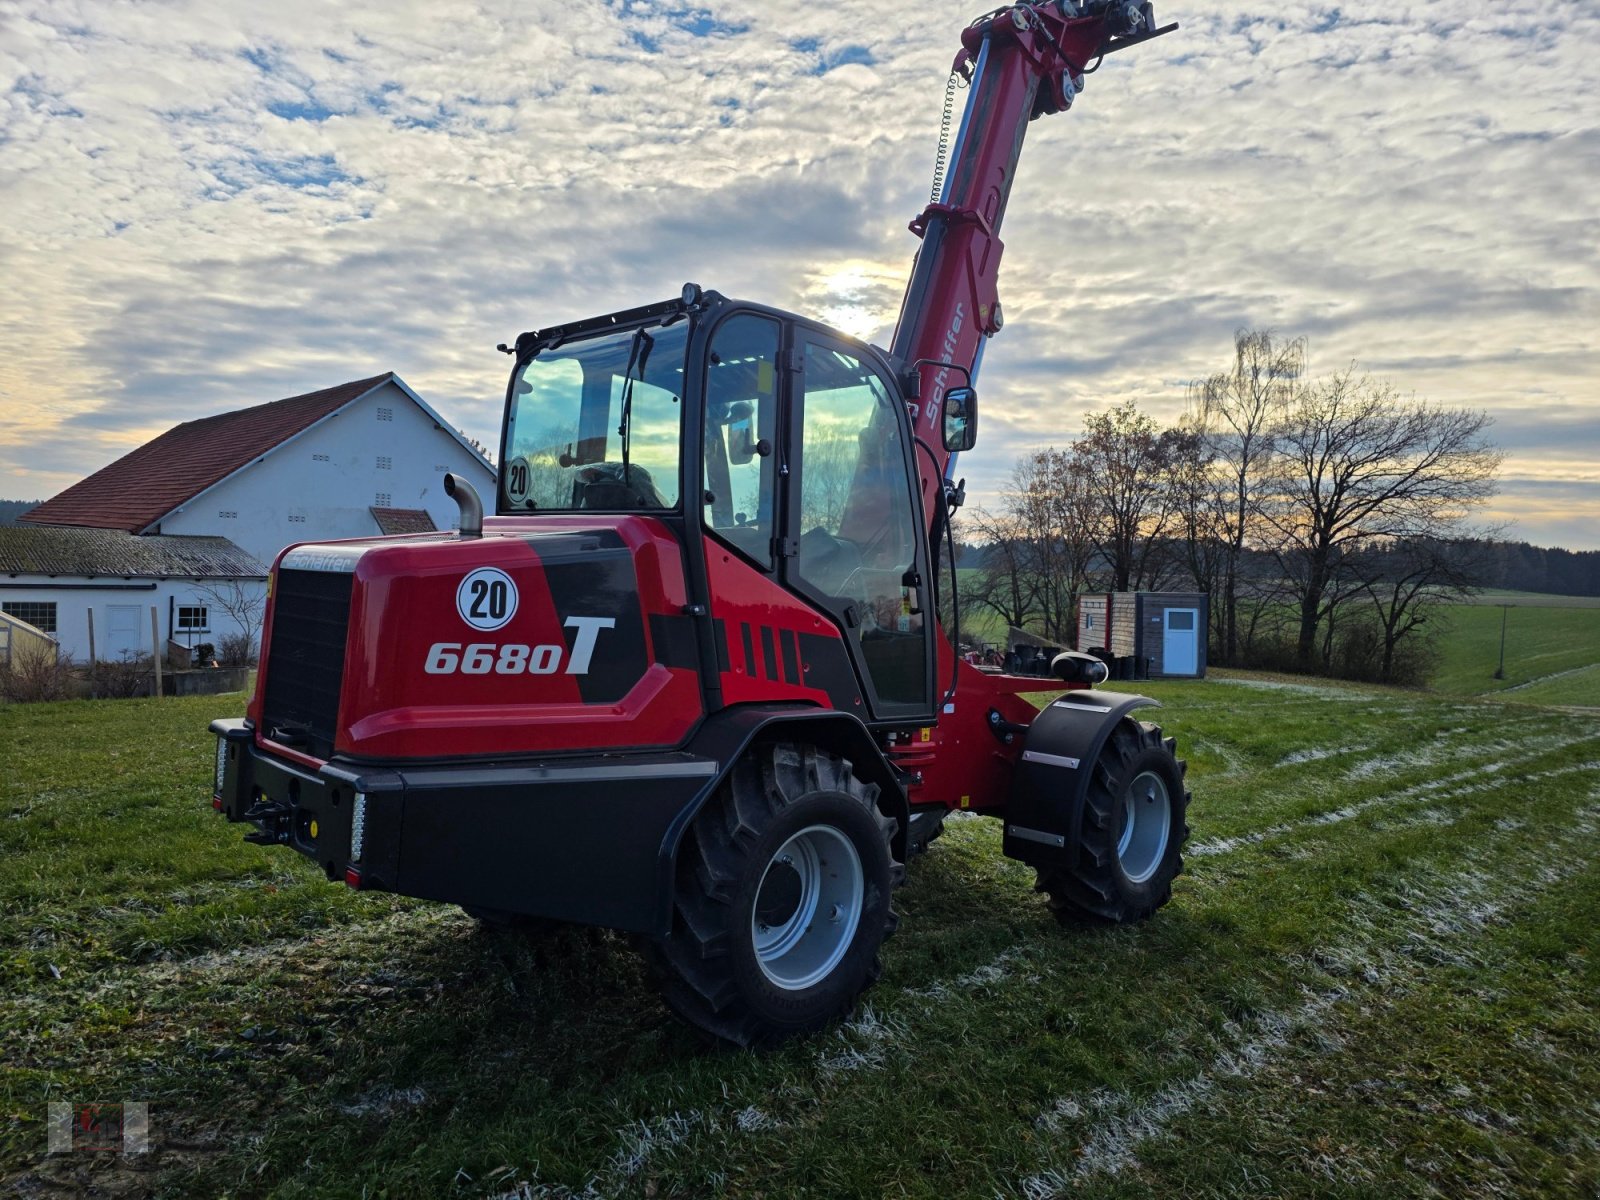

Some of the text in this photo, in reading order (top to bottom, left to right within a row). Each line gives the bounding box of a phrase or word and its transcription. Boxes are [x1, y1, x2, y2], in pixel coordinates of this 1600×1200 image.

[926, 302, 964, 430] Schäffer
[510, 465, 526, 495] 20
[469, 579, 507, 619] 20
